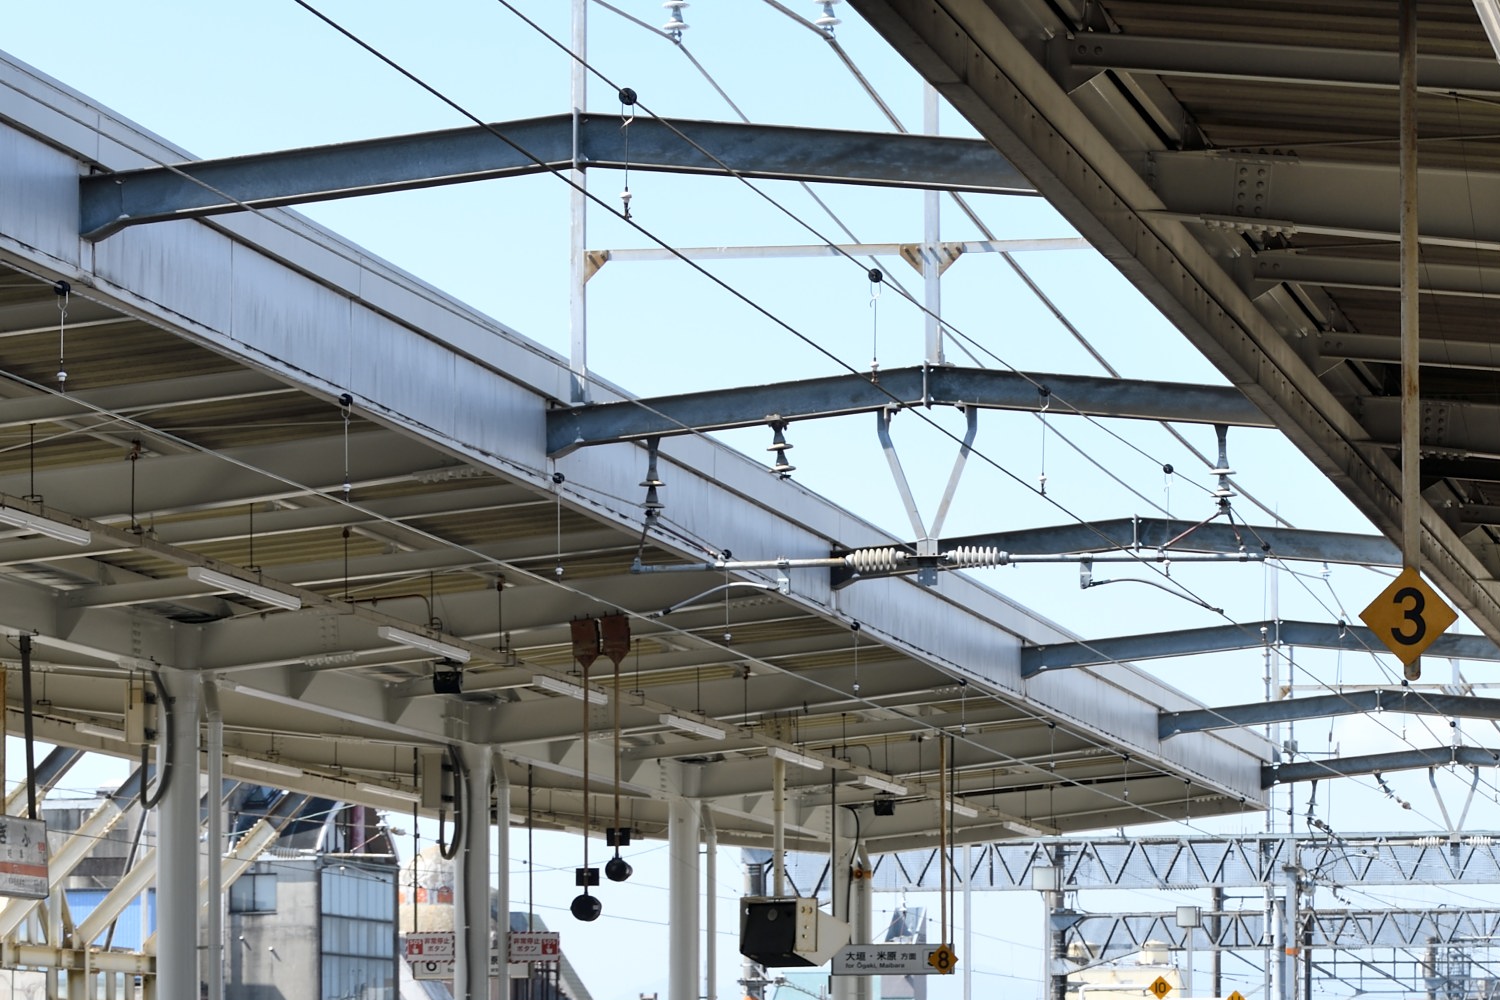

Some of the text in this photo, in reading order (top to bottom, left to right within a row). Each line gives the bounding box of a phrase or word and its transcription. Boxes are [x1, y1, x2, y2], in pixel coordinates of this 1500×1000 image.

[1390, 586, 1426, 646] 3
[845, 951, 917, 961] 大垣・米原 方面
[938, 950, 950, 969] 8
[1154, 982, 1167, 994] 10
